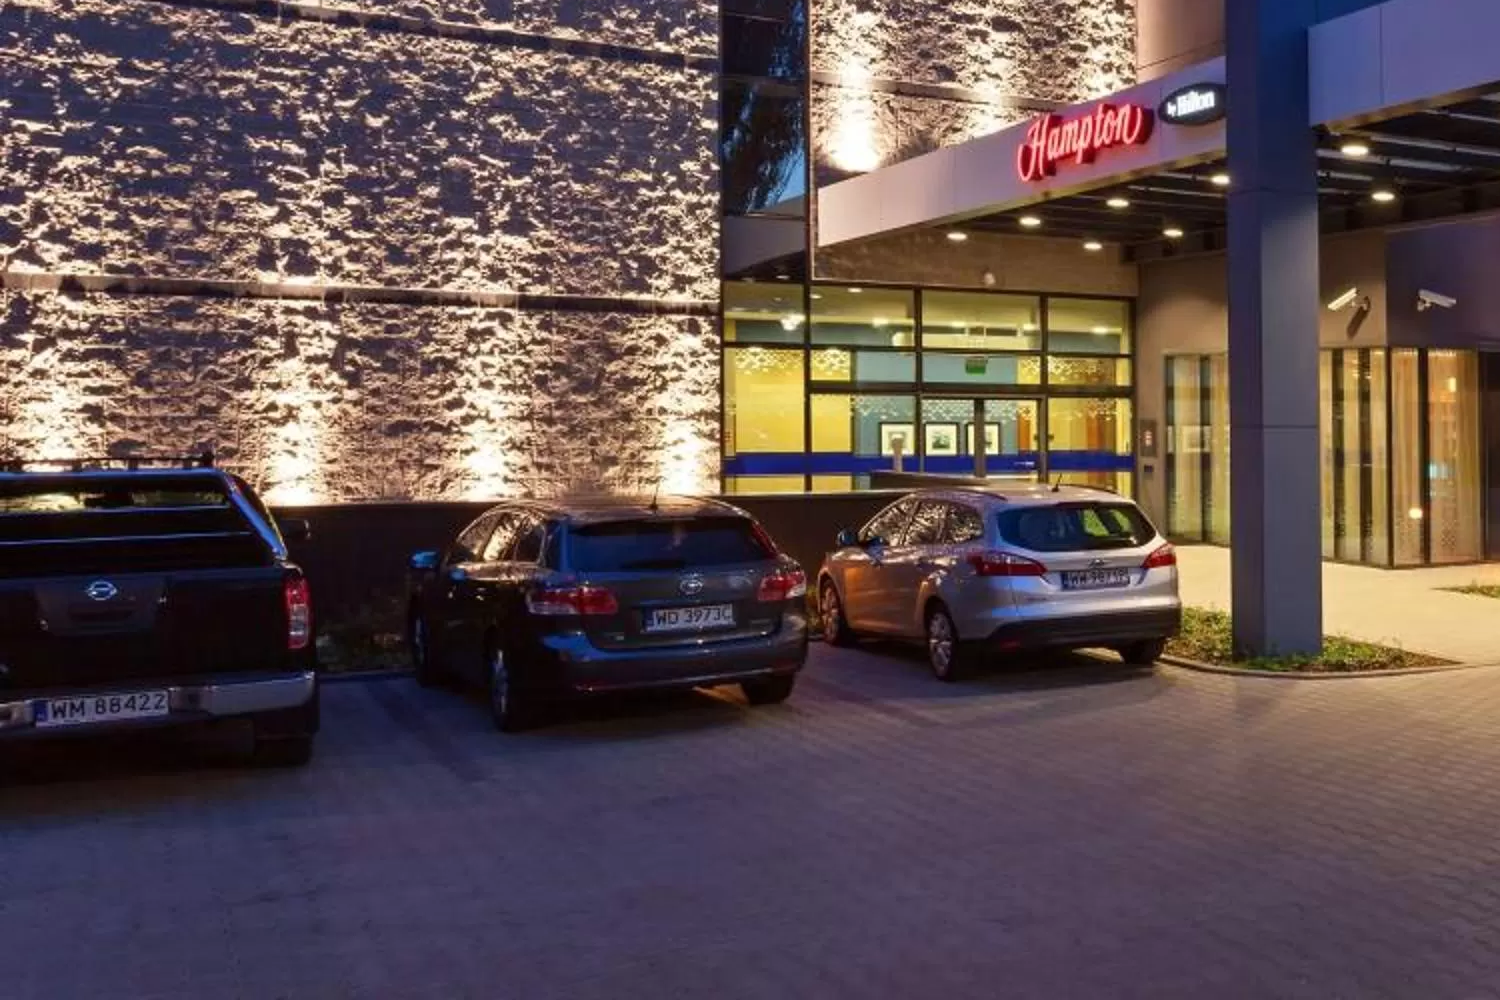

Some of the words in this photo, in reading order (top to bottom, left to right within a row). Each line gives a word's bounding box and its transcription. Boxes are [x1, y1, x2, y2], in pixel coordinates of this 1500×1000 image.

[1177, 90, 1215, 116] Hilton
[1017, 103, 1143, 182] Hampton
[655, 609, 680, 625] WD
[51, 701, 85, 718] WM
